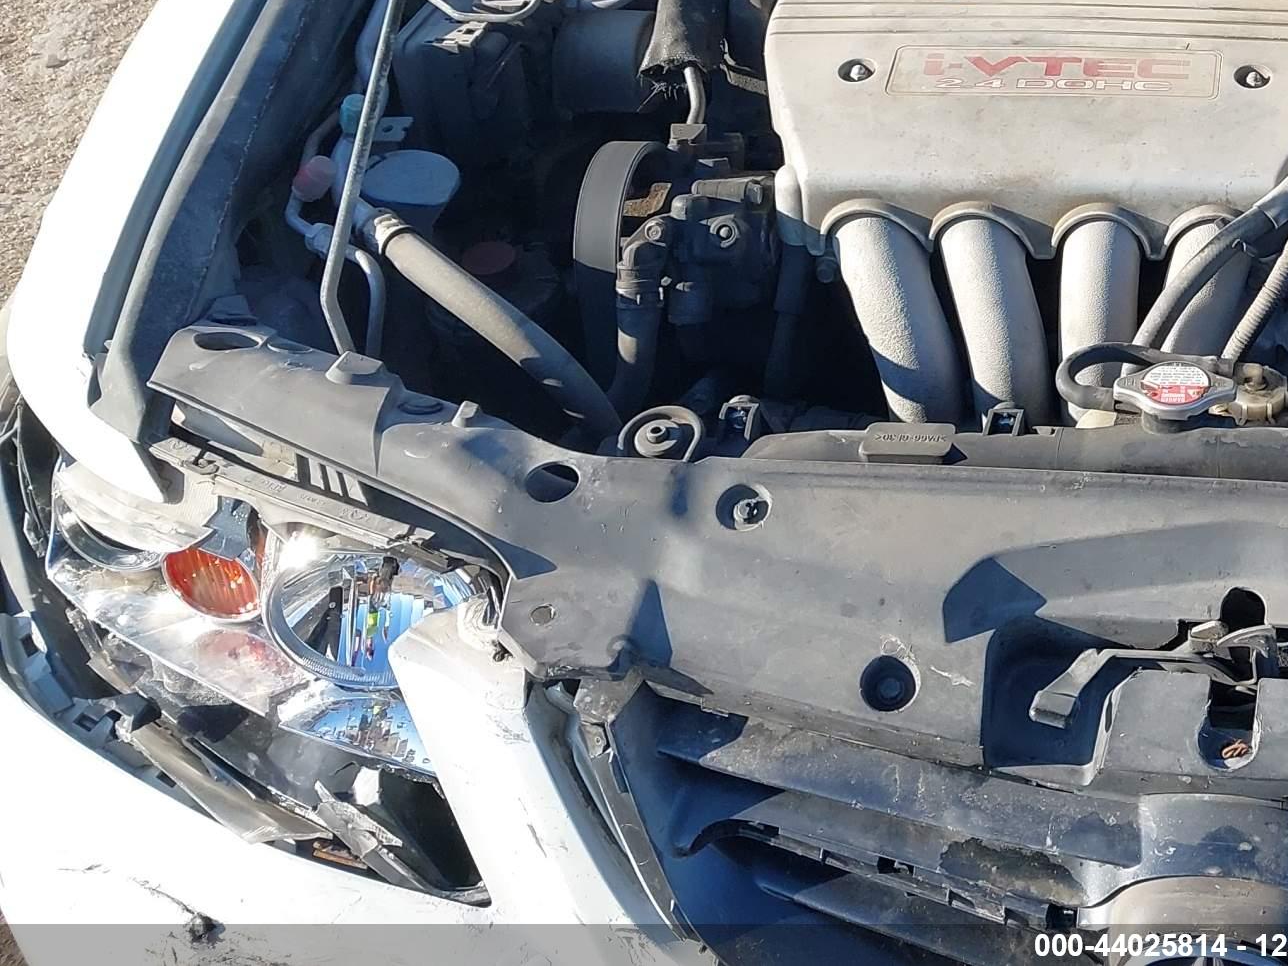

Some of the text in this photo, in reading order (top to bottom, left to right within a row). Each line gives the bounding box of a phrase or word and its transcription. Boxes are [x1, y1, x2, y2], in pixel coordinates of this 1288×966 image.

[923, 53, 1191, 80] i-VTEC
[935, 77, 1172, 91] 2.4 DOHC
